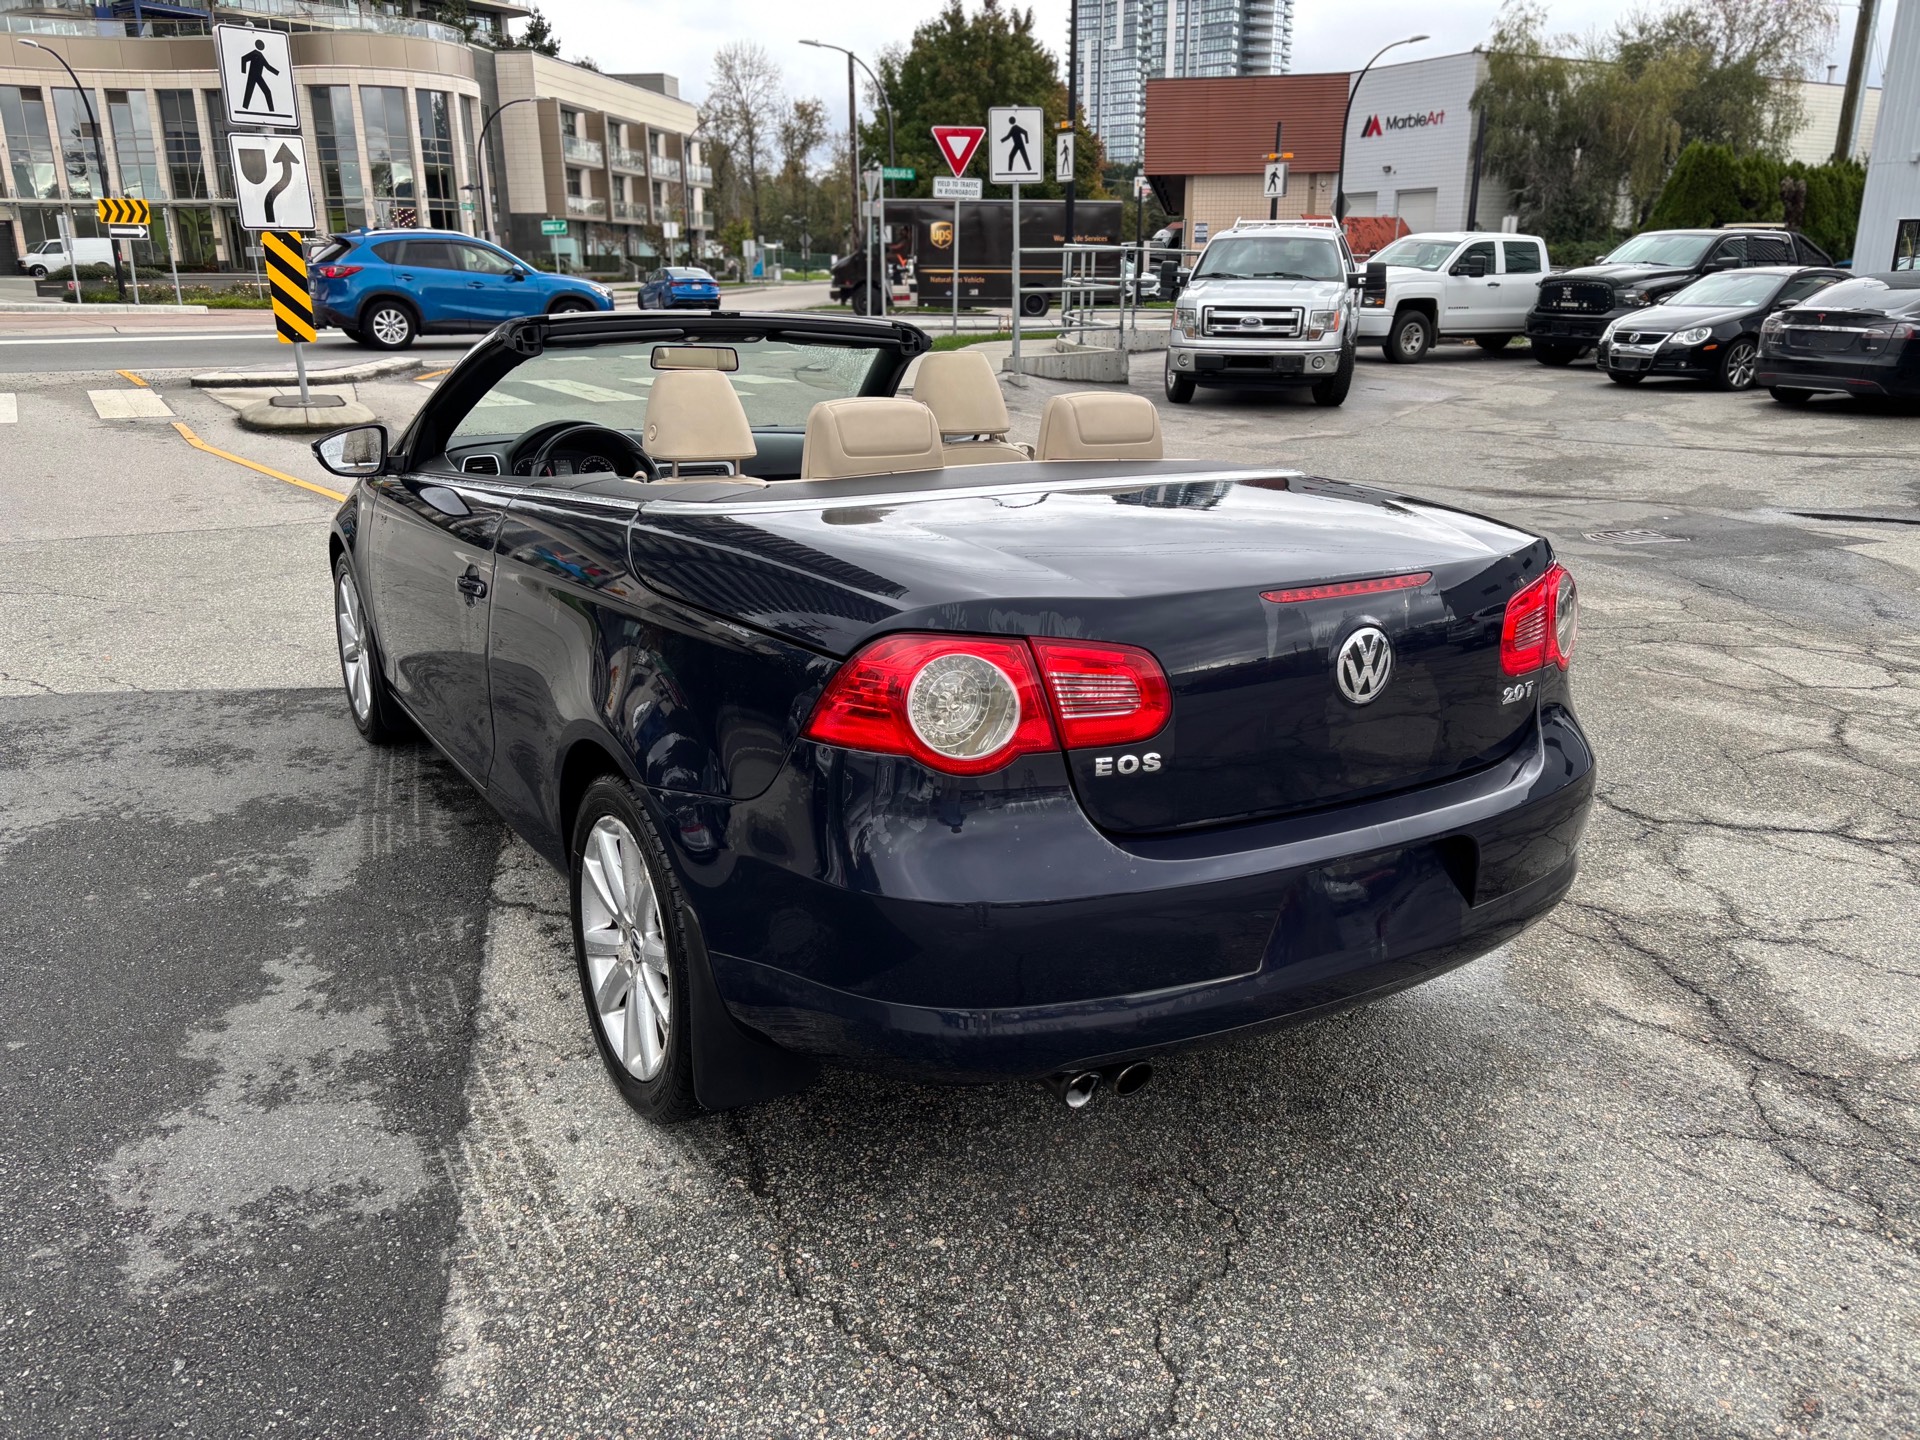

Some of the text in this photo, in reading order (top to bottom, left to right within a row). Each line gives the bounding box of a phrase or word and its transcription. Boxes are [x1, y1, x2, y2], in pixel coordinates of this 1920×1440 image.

[1386, 110, 1445, 130] MarbleArt
[960, 181, 979, 189] TRAFFIC
[1095, 752, 1162, 777] EOS
